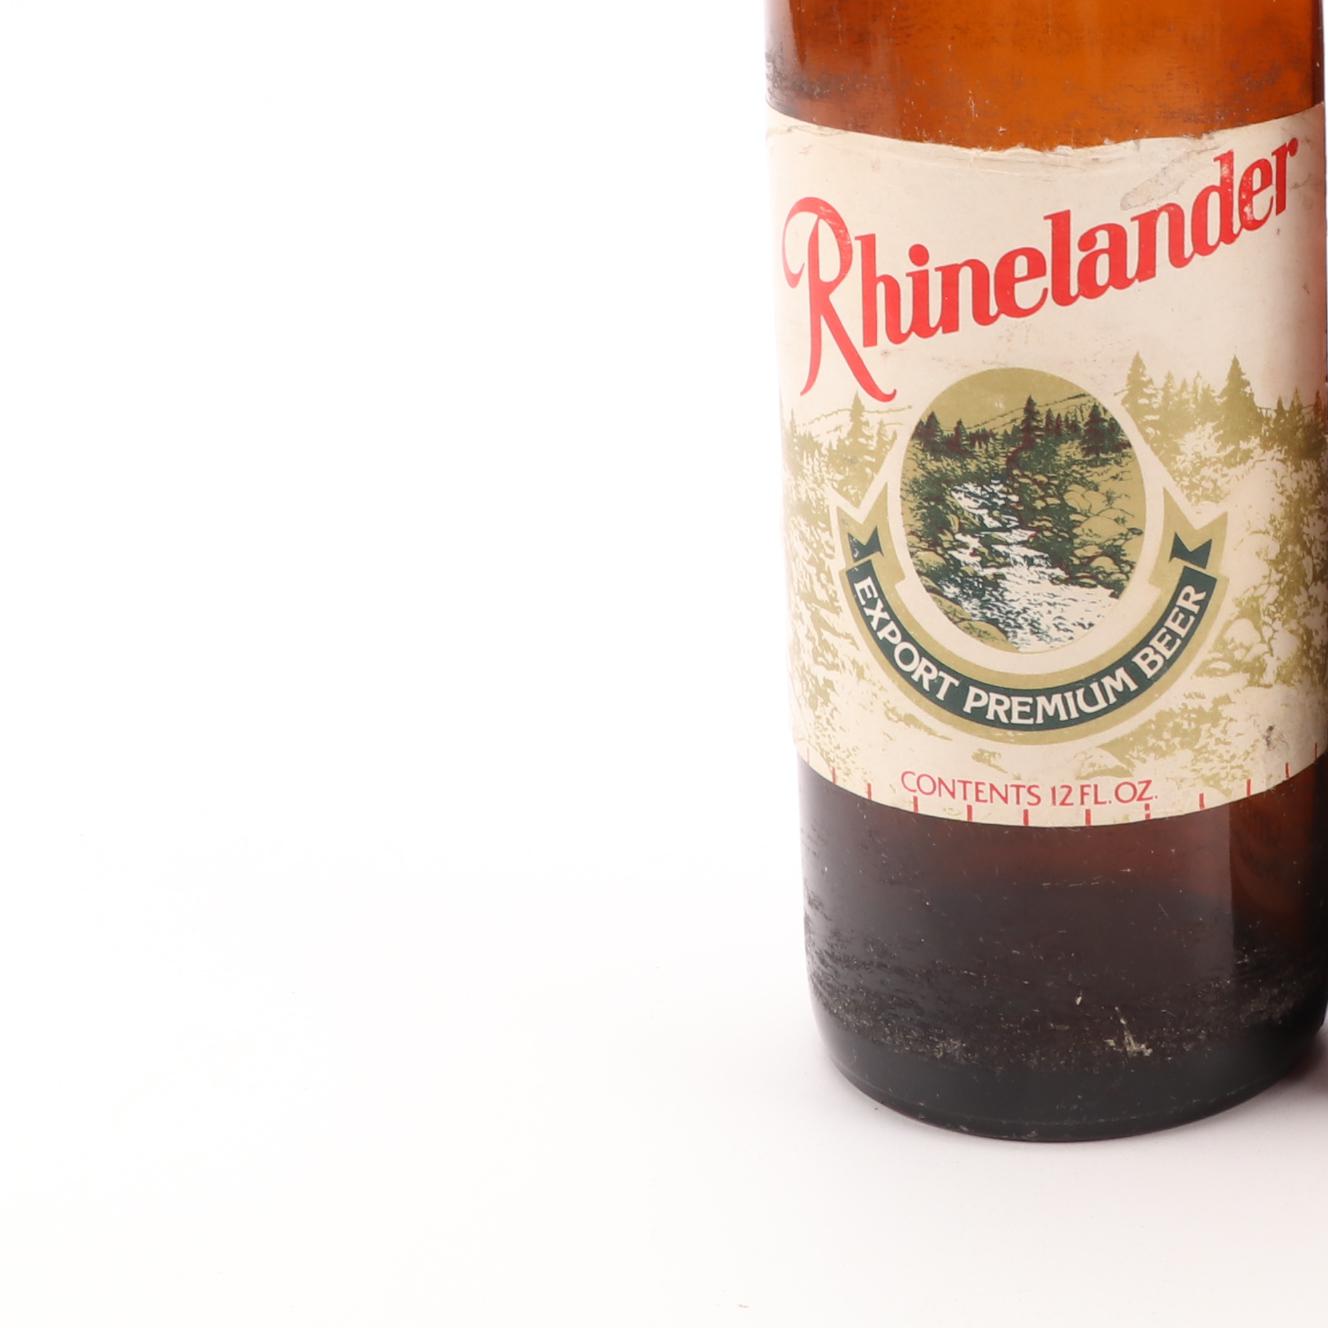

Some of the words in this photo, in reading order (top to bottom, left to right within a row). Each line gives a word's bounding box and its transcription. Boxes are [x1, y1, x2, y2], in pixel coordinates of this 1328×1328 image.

[782, 137, 1299, 403] Rhinelander
[853, 575, 961, 702] EXPORT
[963, 666, 1138, 726] PREMIUM
[1131, 584, 1208, 680] BEER
[900, 770, 1041, 807] CONTENTS
[1050, 784, 1075, 807] 12
